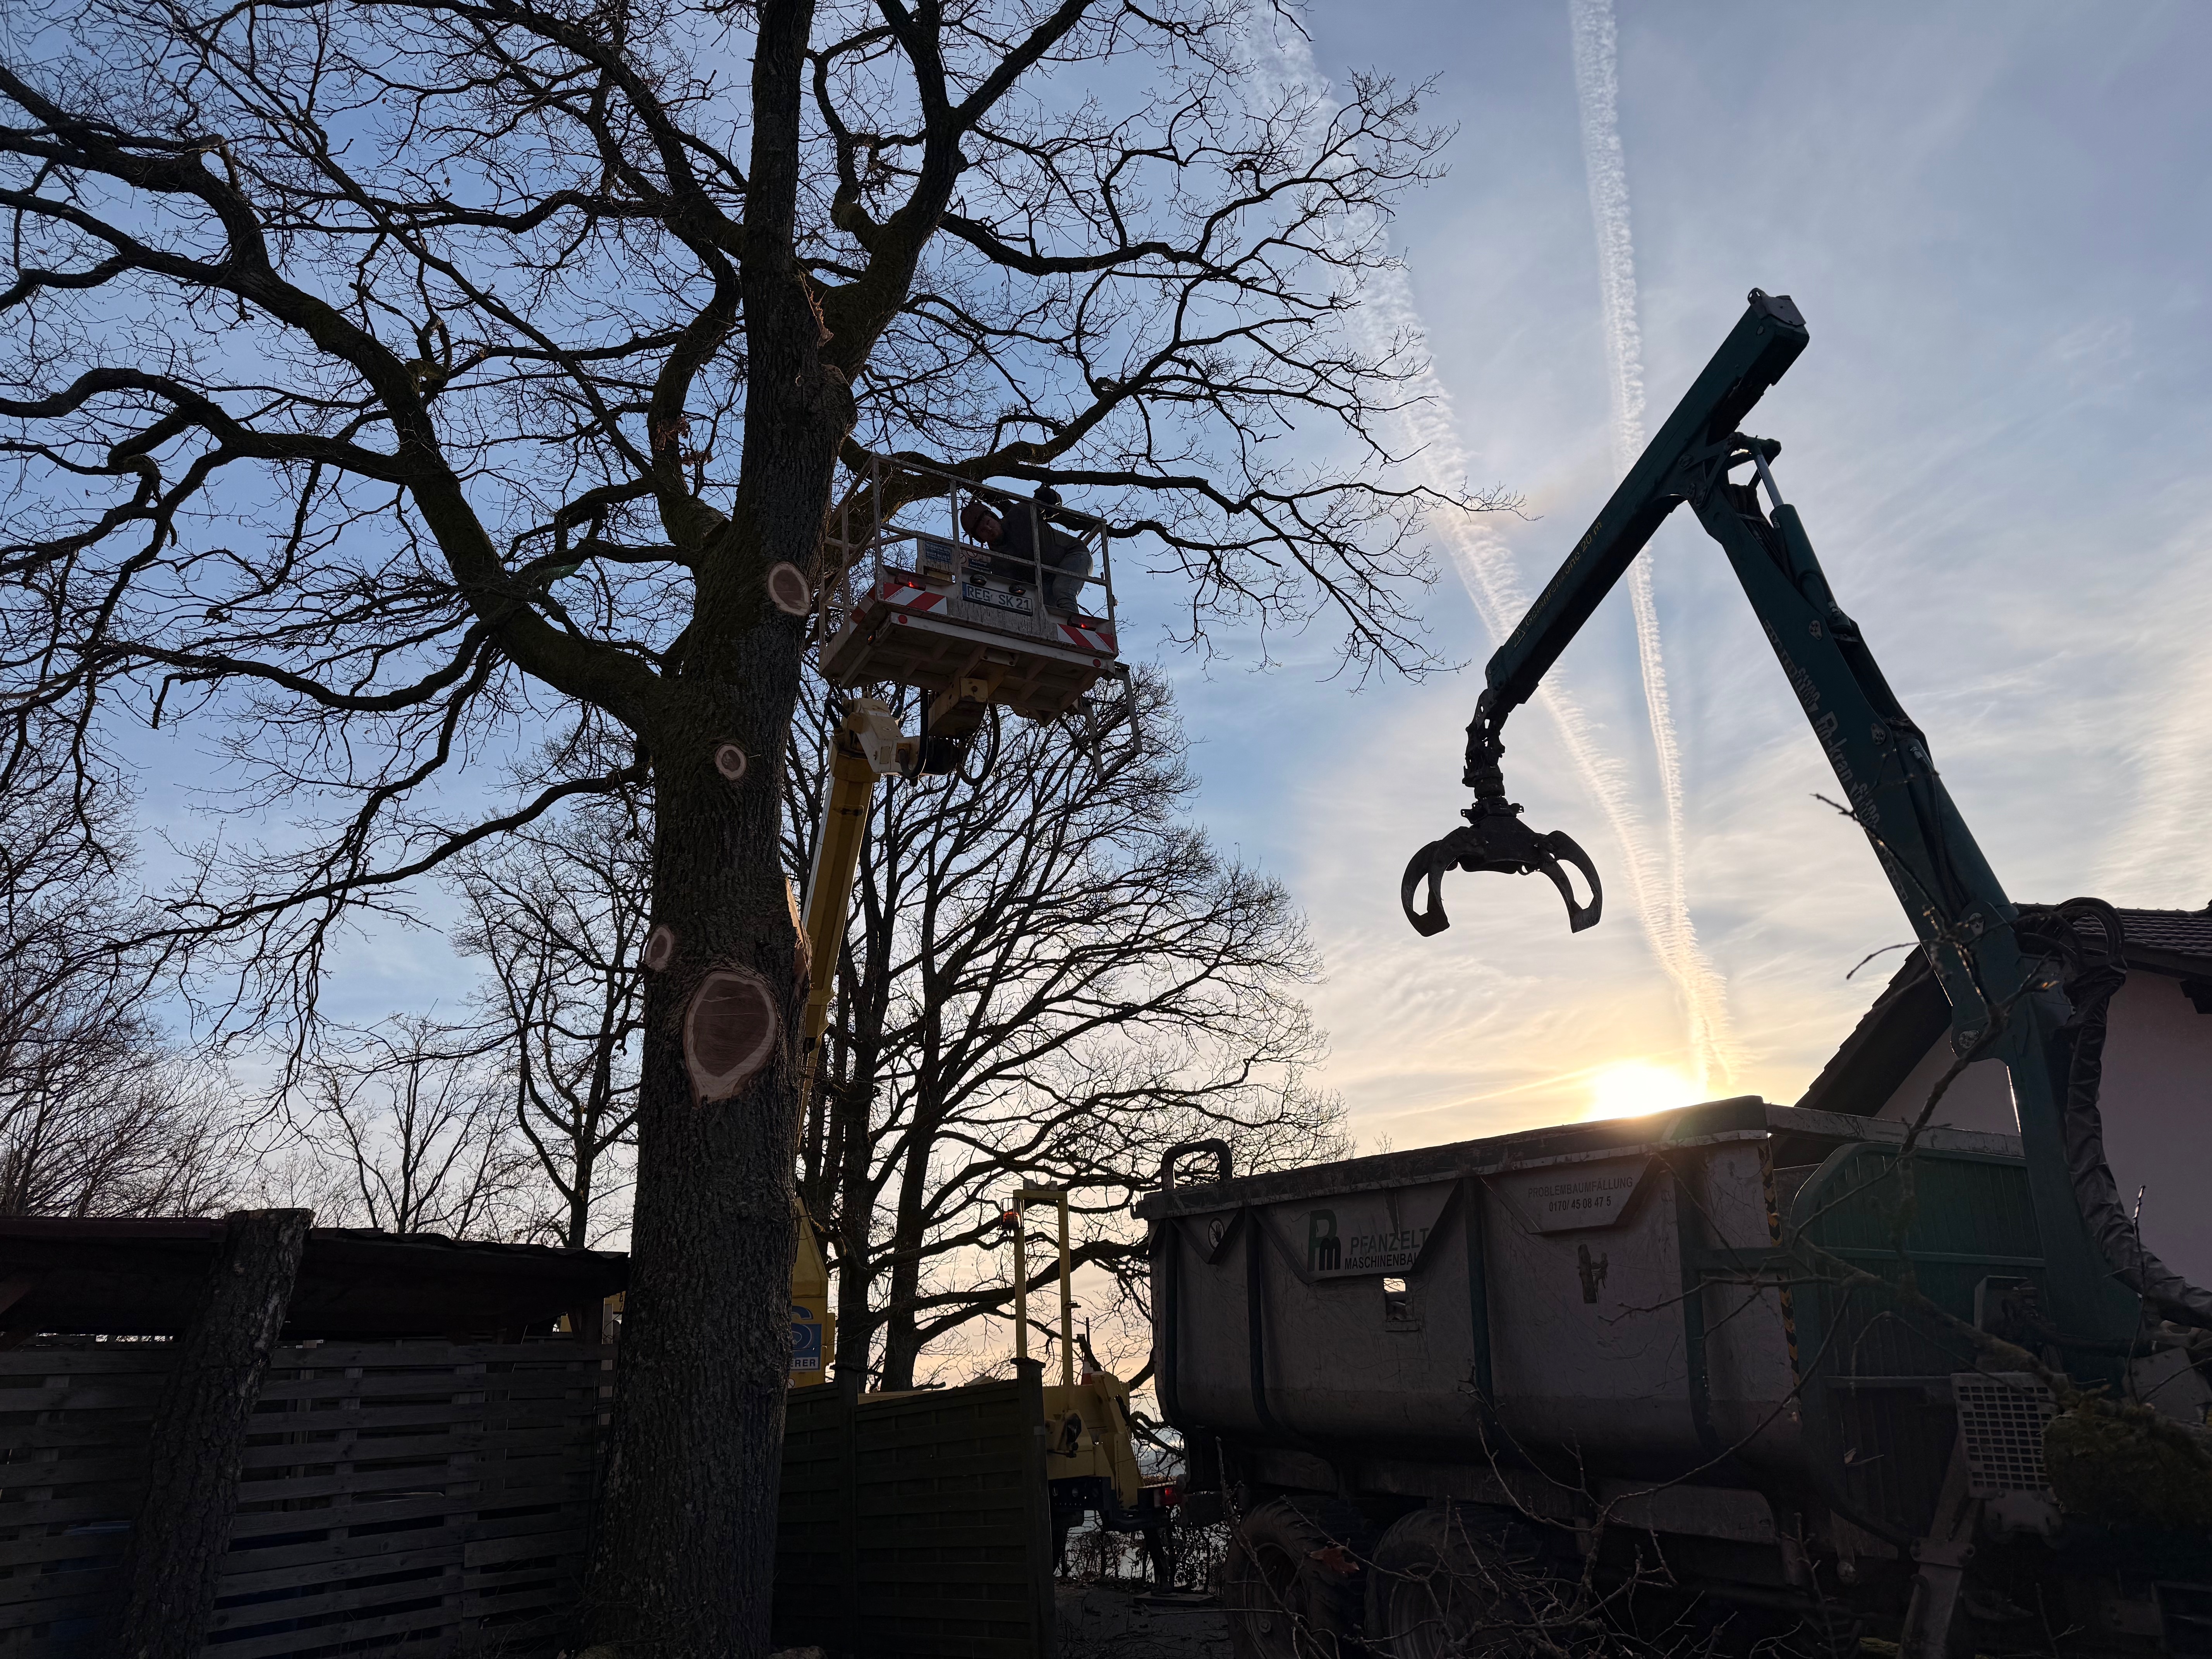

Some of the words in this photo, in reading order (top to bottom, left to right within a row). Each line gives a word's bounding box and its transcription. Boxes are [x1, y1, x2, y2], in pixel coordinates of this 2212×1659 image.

[1581, 534, 1592, 552] 20
[1594, 522, 1602, 535] m
[967, 586, 991, 602] REG
[999, 594, 1013, 607] SK
[1016, 598, 1031, 611] 21
[1528, 1176, 1633, 1198] PROBLEMBAUMFÄLLUNG
[1571, 1199, 1580, 1209] 45
[1583, 1198, 1592, 1209] 08
[1594, 1197, 1604, 1207] 47
[1607, 1196, 1611, 1206] 5
[1350, 1227, 1429, 1255] PFANZELT
